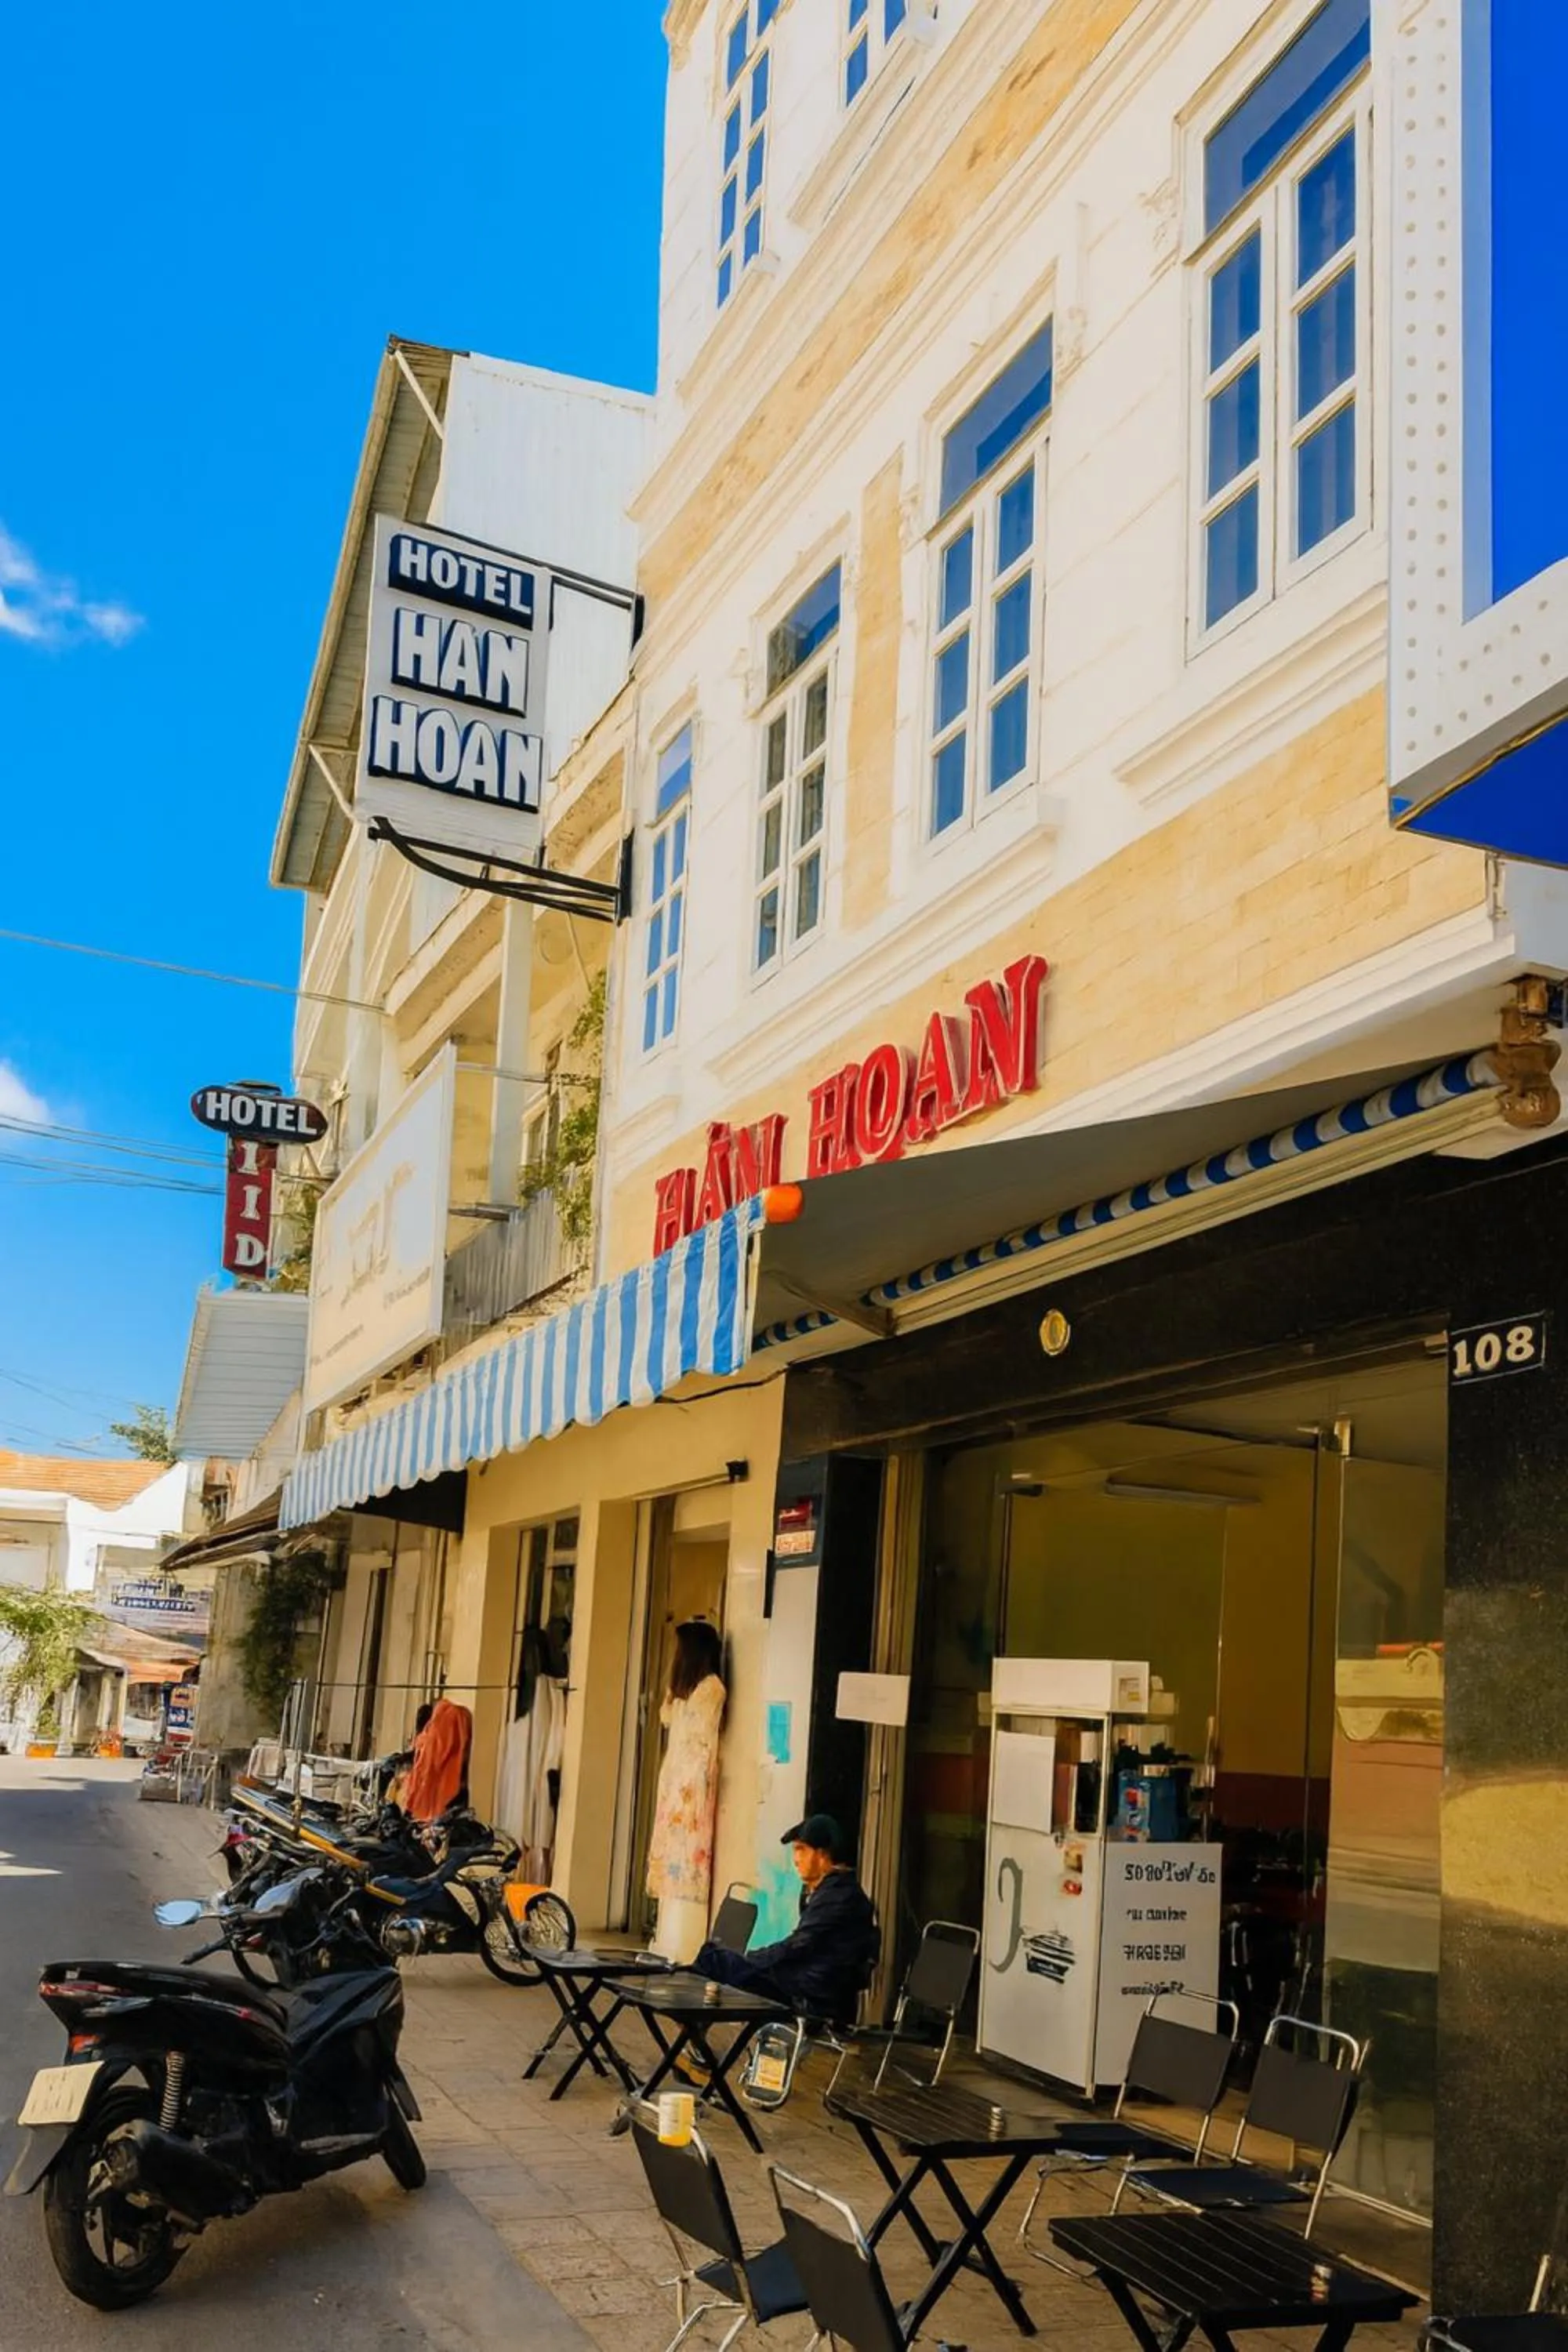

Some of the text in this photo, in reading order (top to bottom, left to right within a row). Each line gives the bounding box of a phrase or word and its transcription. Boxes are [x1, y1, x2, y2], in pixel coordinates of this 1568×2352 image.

[398, 538, 532, 615] HOTEL
[370, 695, 543, 811] HOAN
[807, 953, 1048, 1179] HOAN
[205, 1091, 318, 1135] HOTEL
[1453, 1326, 1534, 1377] 108
